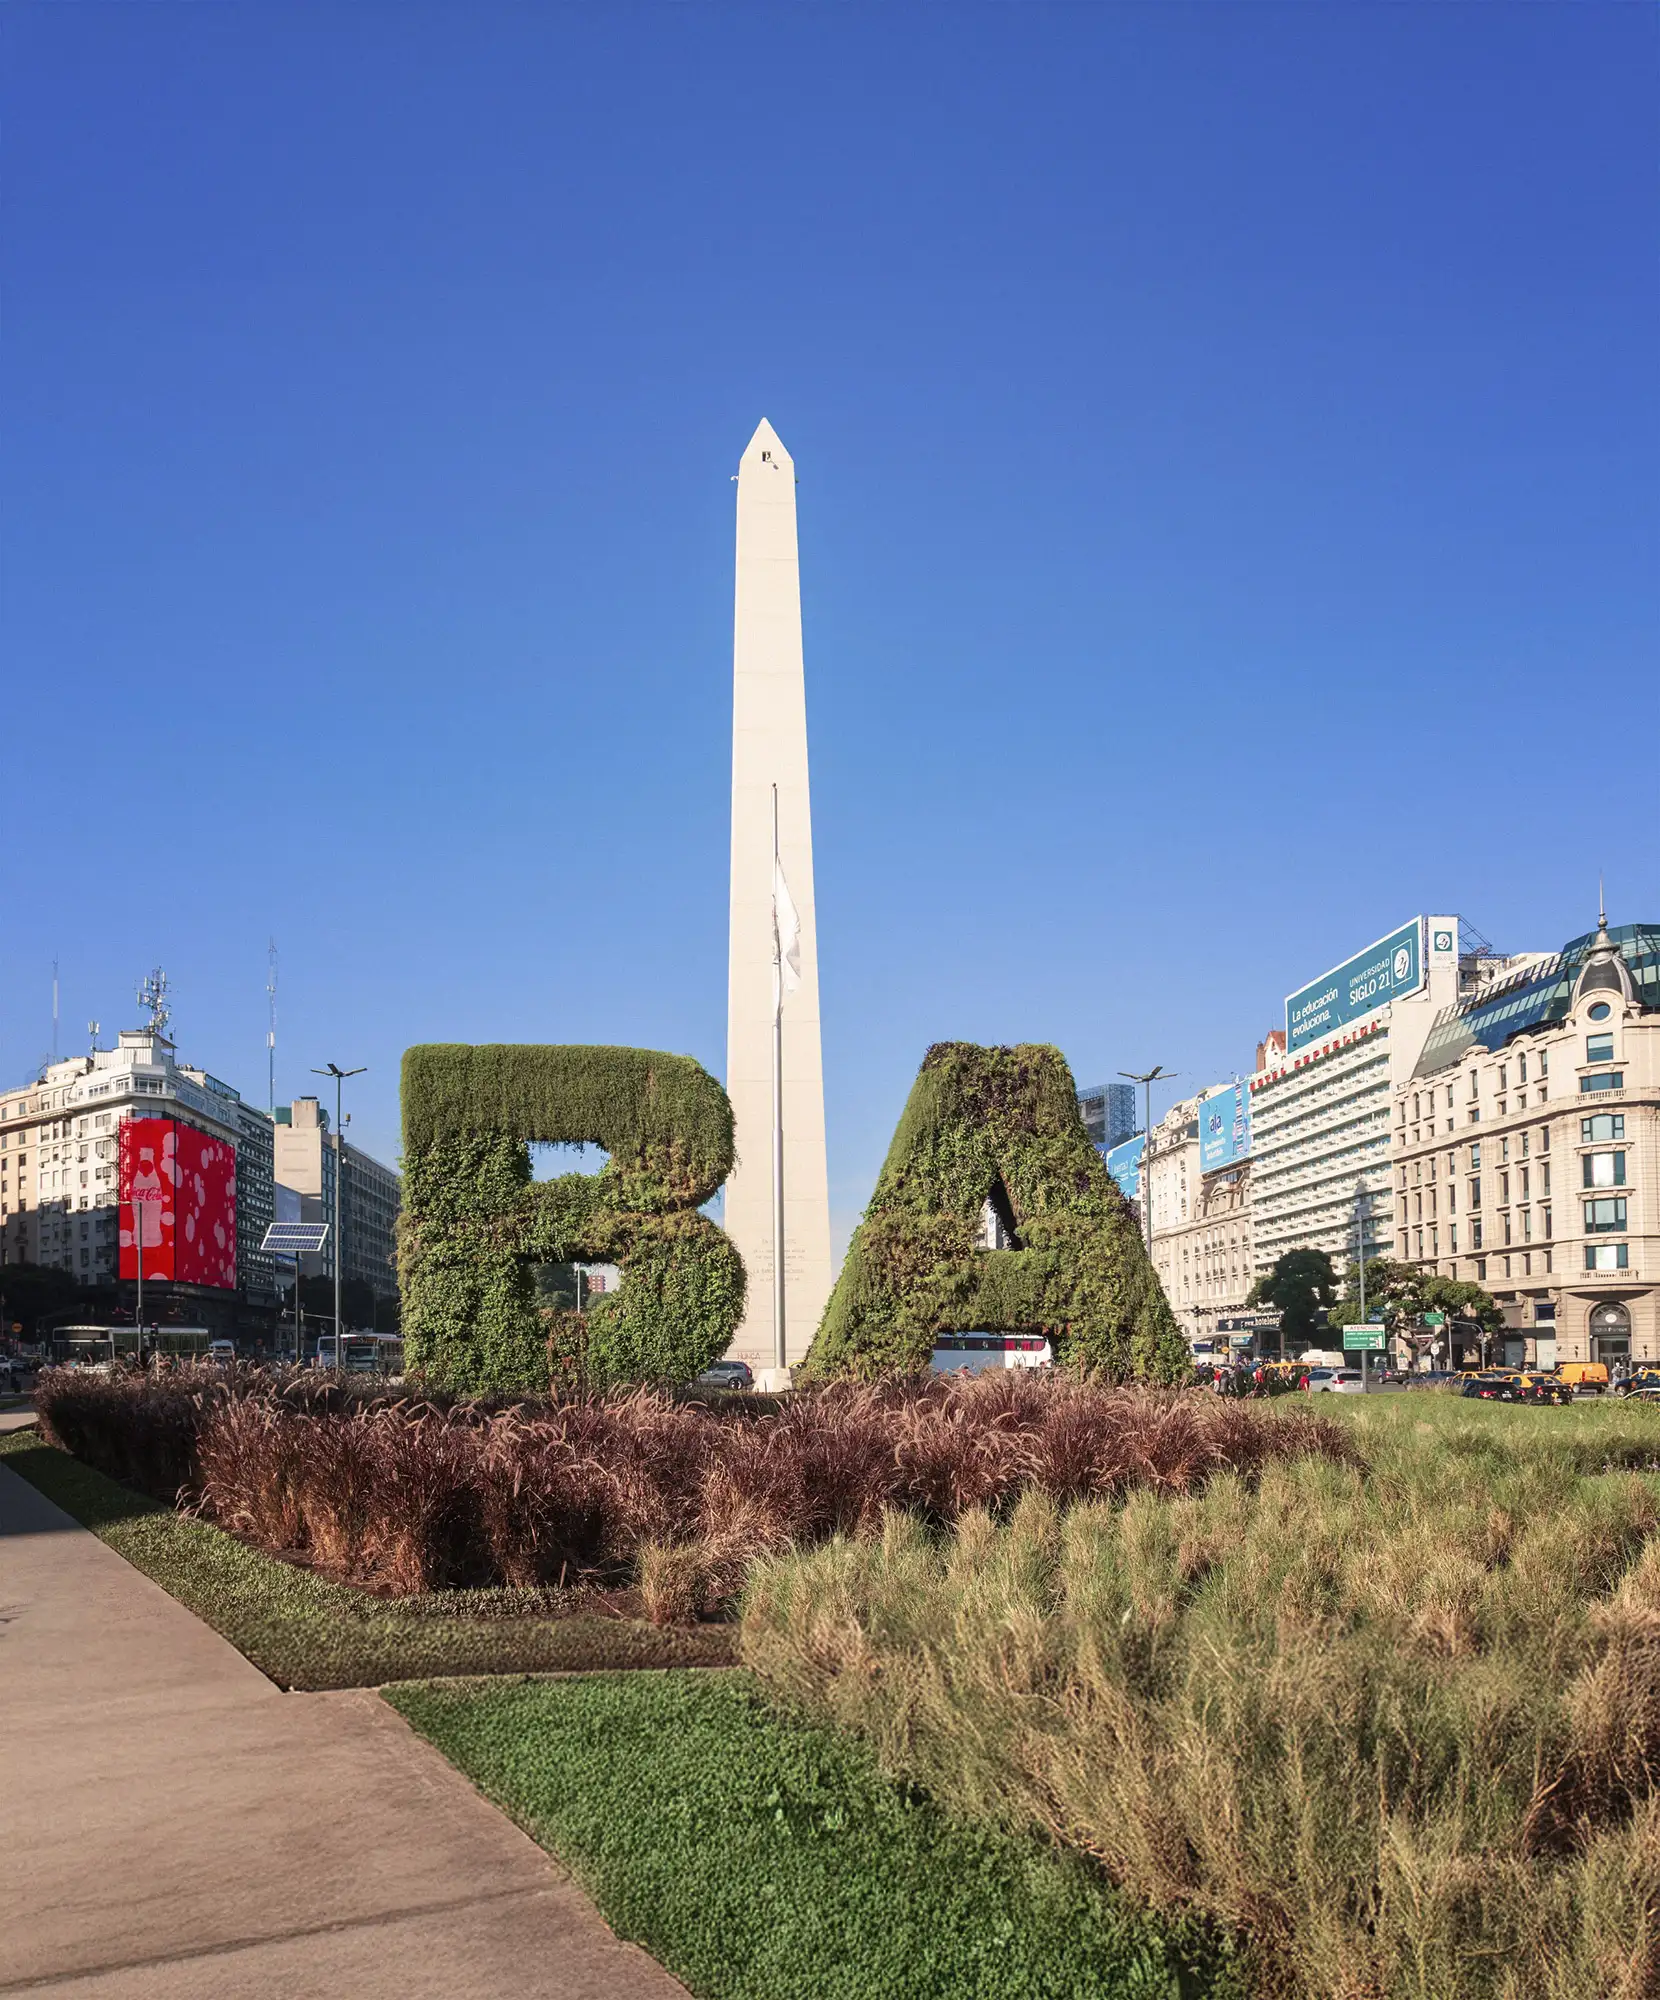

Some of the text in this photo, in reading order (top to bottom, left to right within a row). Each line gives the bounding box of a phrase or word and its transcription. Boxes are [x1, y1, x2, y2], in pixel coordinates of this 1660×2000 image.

[1349, 958, 1390, 988] UNIVERSIDAD
[1349, 970, 1390, 1005] SIGLO 21
[1292, 987, 1338, 1023] La educación
[1292, 1009, 1331, 1038] evoluciona.
[1249, 1020, 1378, 1091] HOTEL REPUBLICA
